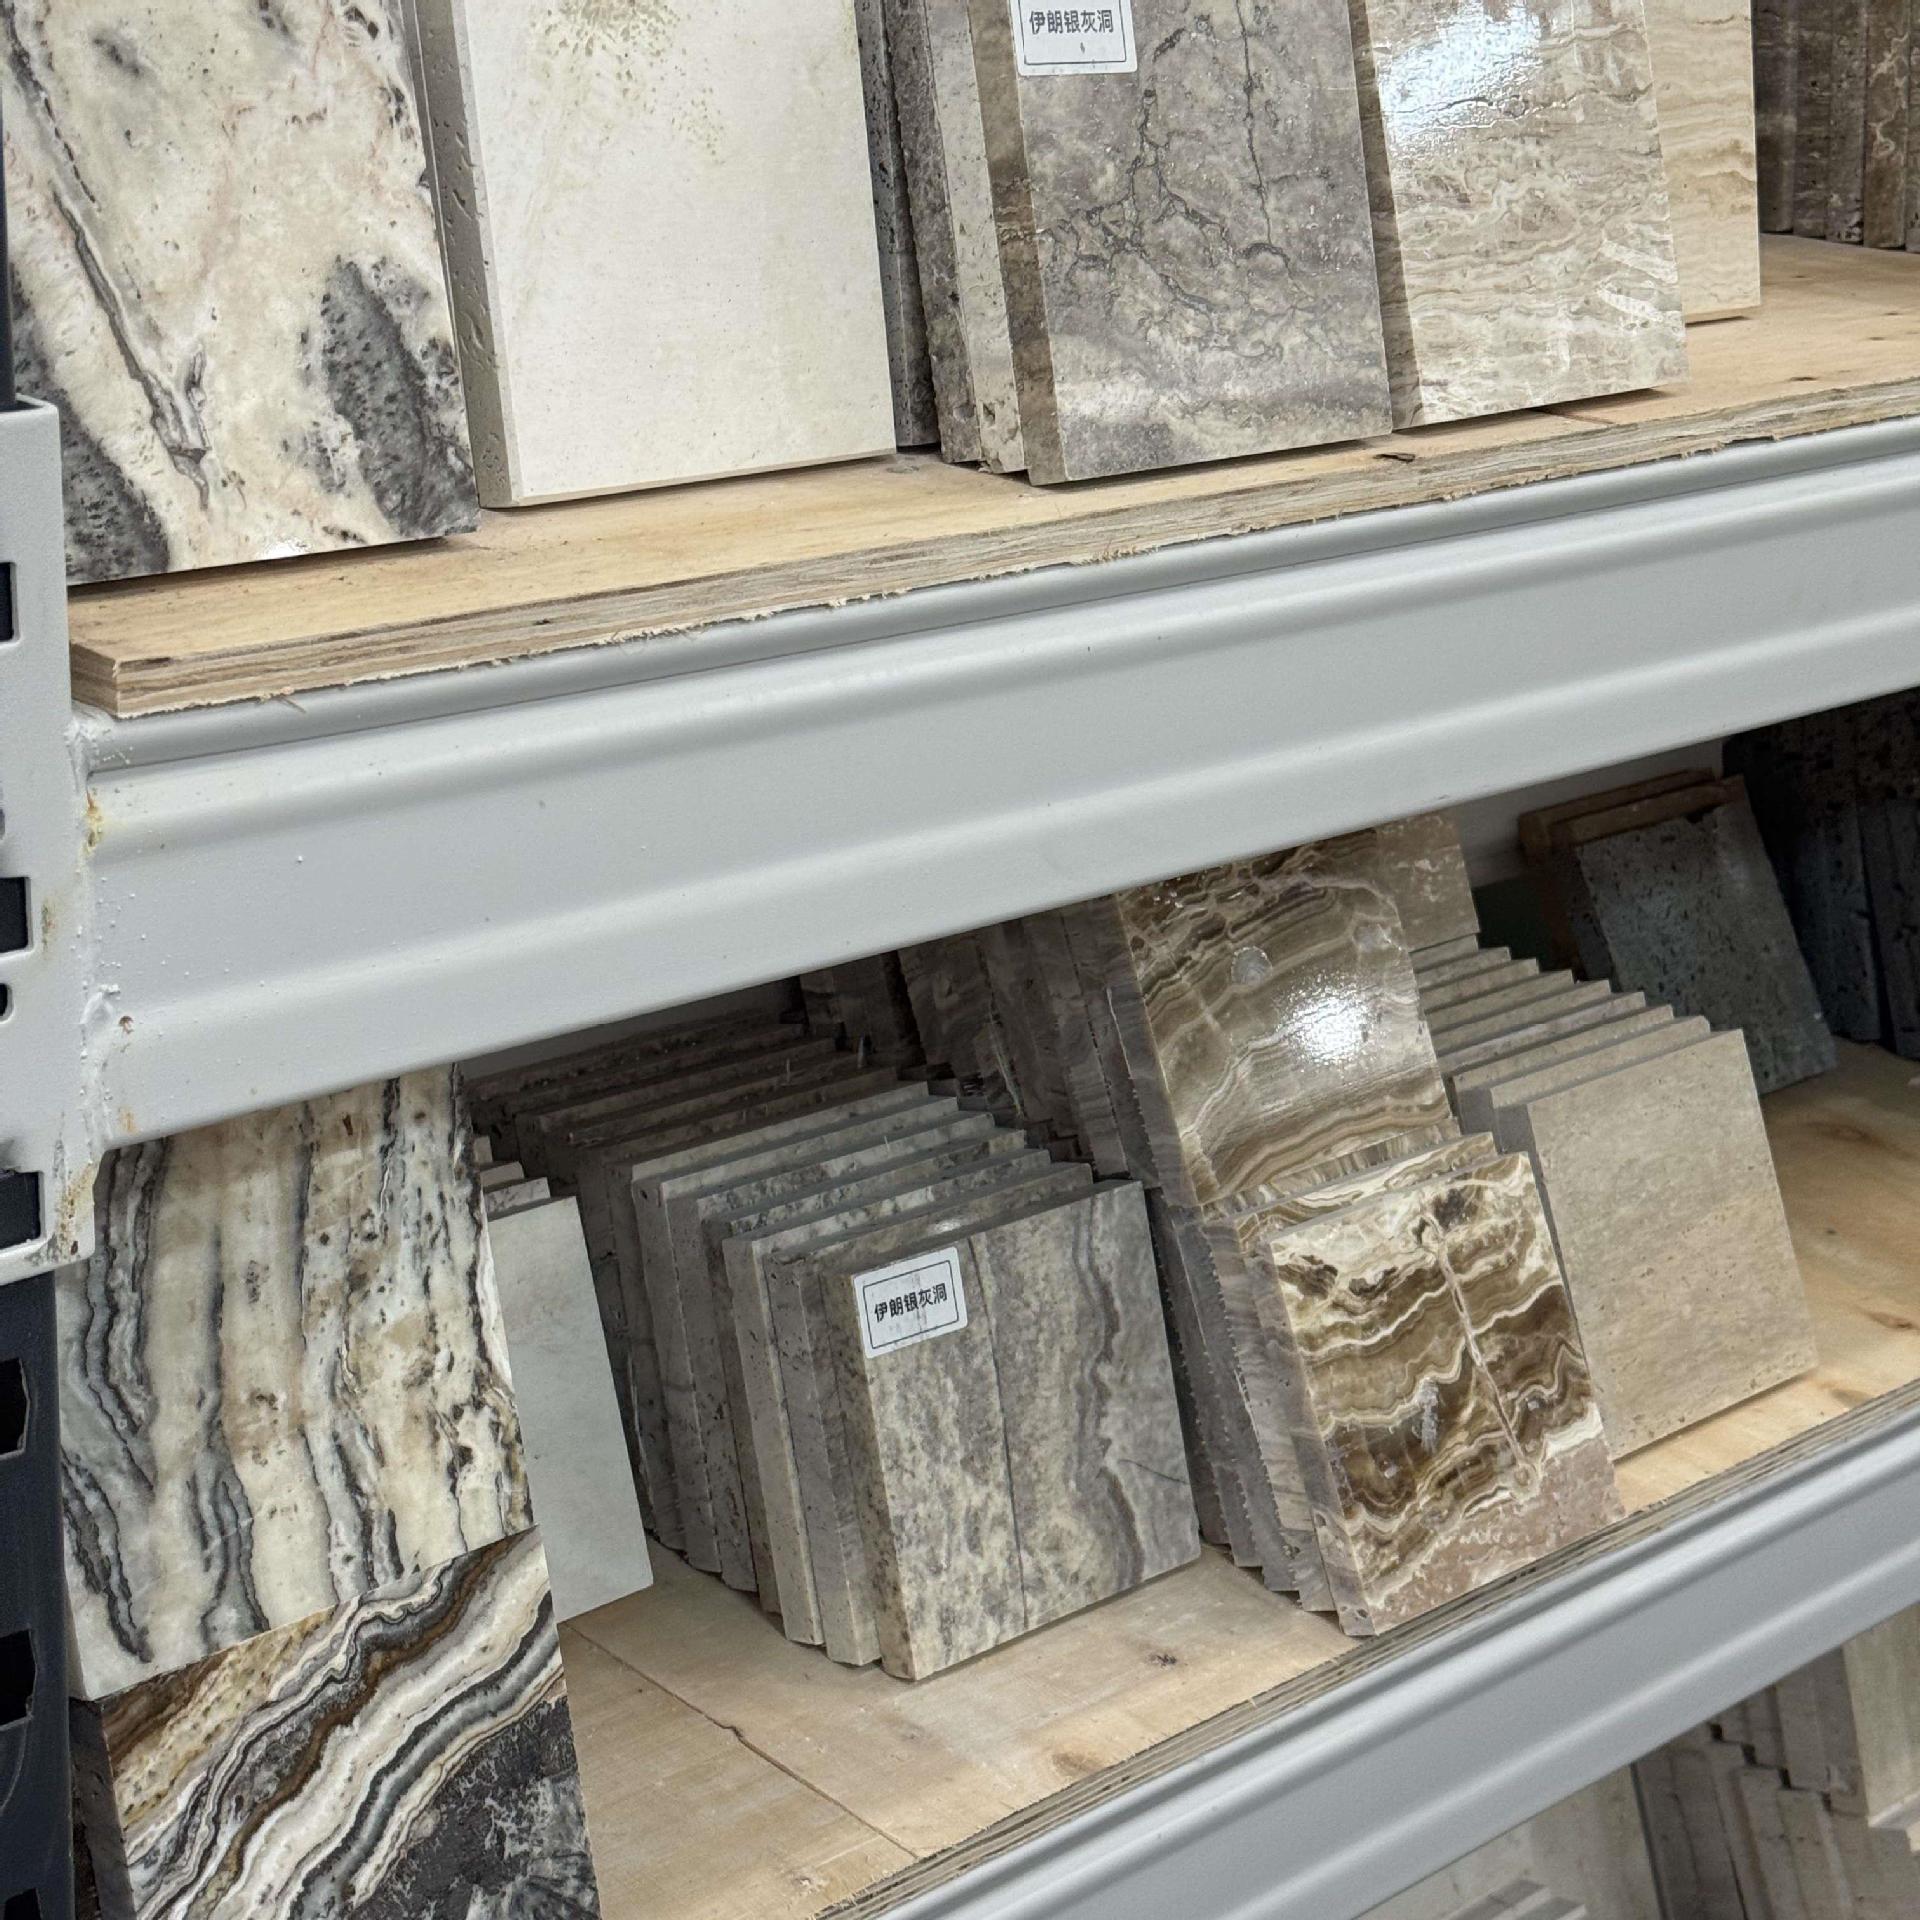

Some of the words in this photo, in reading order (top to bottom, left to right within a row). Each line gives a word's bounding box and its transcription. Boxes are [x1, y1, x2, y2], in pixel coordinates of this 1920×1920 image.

[1029, 9, 1114, 35] 伊朗银灰洞
[874, 1283, 947, 1323] 伊朗银灰洞
